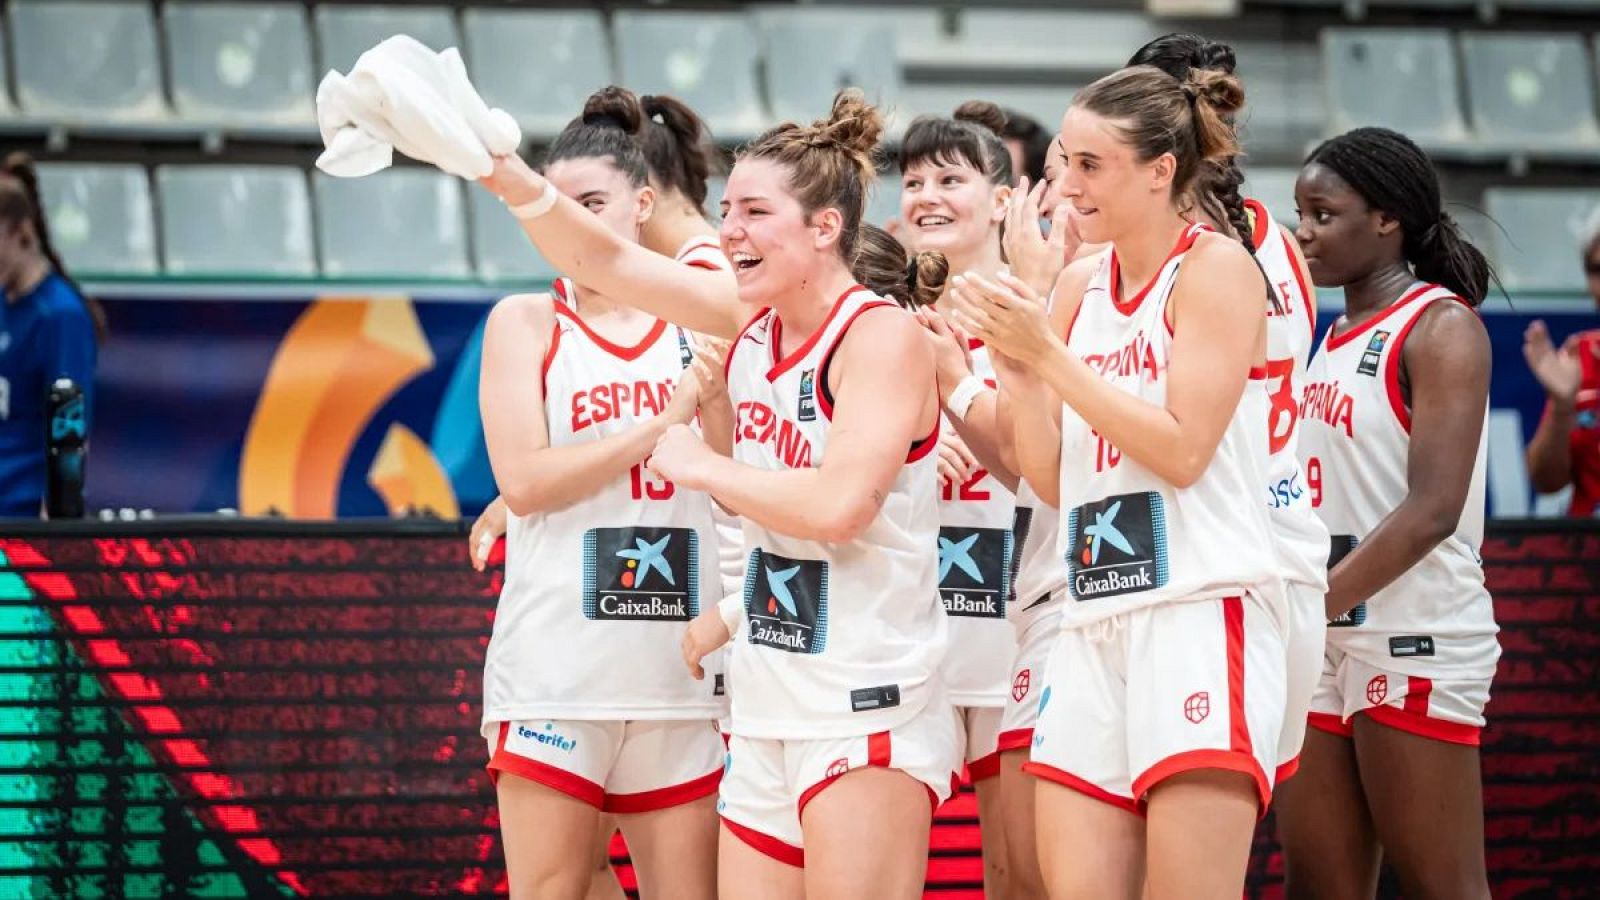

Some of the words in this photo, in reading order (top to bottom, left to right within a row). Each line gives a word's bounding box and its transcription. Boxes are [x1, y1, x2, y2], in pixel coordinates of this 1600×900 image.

[571, 378, 703, 432] ESPAÑ
[1307, 457, 1322, 507] 9
[1075, 567, 1152, 596] CaixaBank
[600, 595, 686, 618] CaixaBank
[942, 593, 997, 613] aBank
